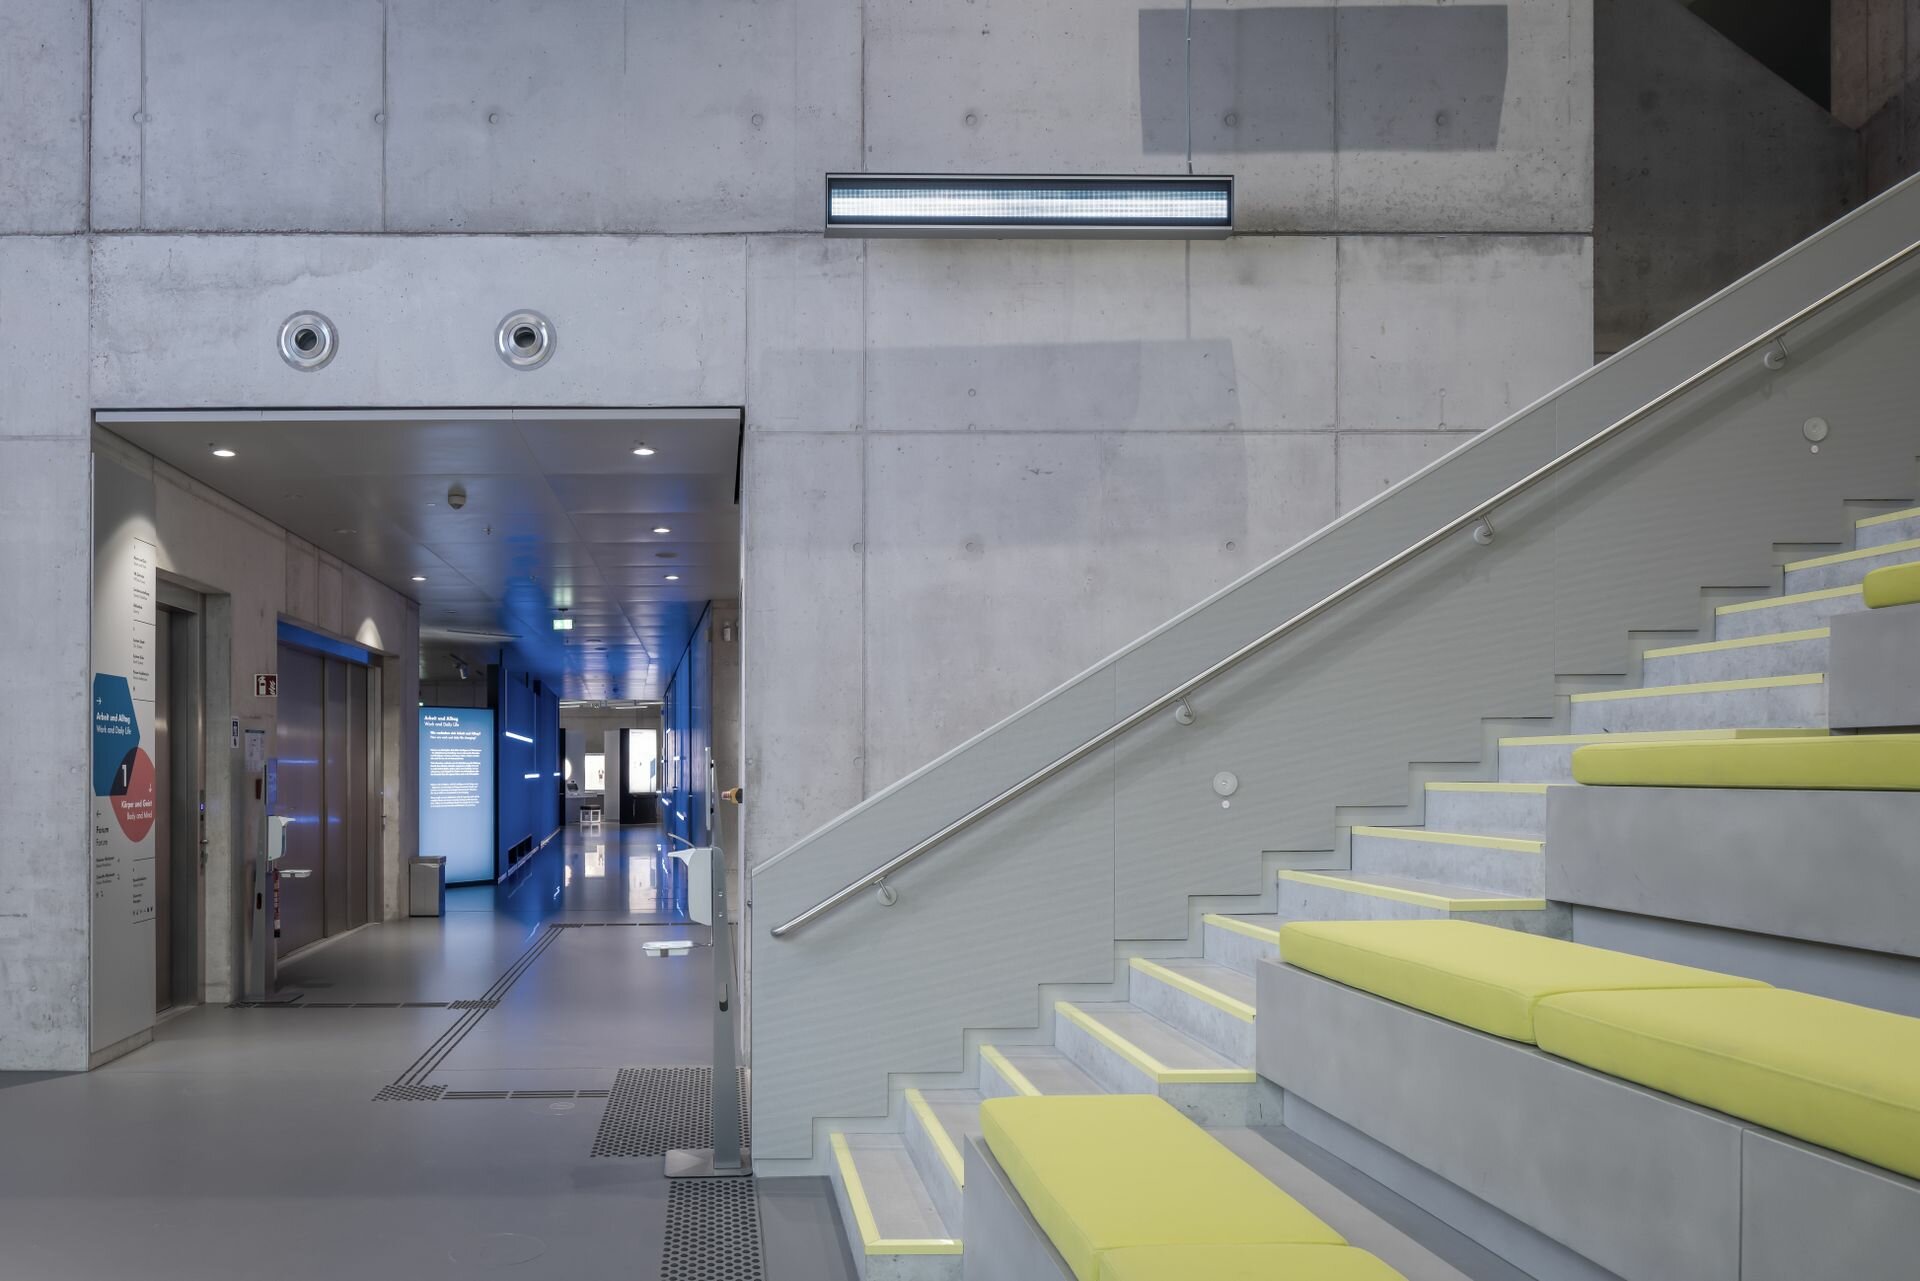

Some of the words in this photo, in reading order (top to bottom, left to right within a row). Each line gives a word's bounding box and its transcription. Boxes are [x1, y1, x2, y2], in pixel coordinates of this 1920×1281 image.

[96, 712, 109, 720] Arbeit
[110, 713, 118, 721] und
[118, 714, 130, 724] Alltag
[96, 725, 107, 733] Work
[115, 726, 125, 736] Daily
[122, 764, 127, 787] 1
